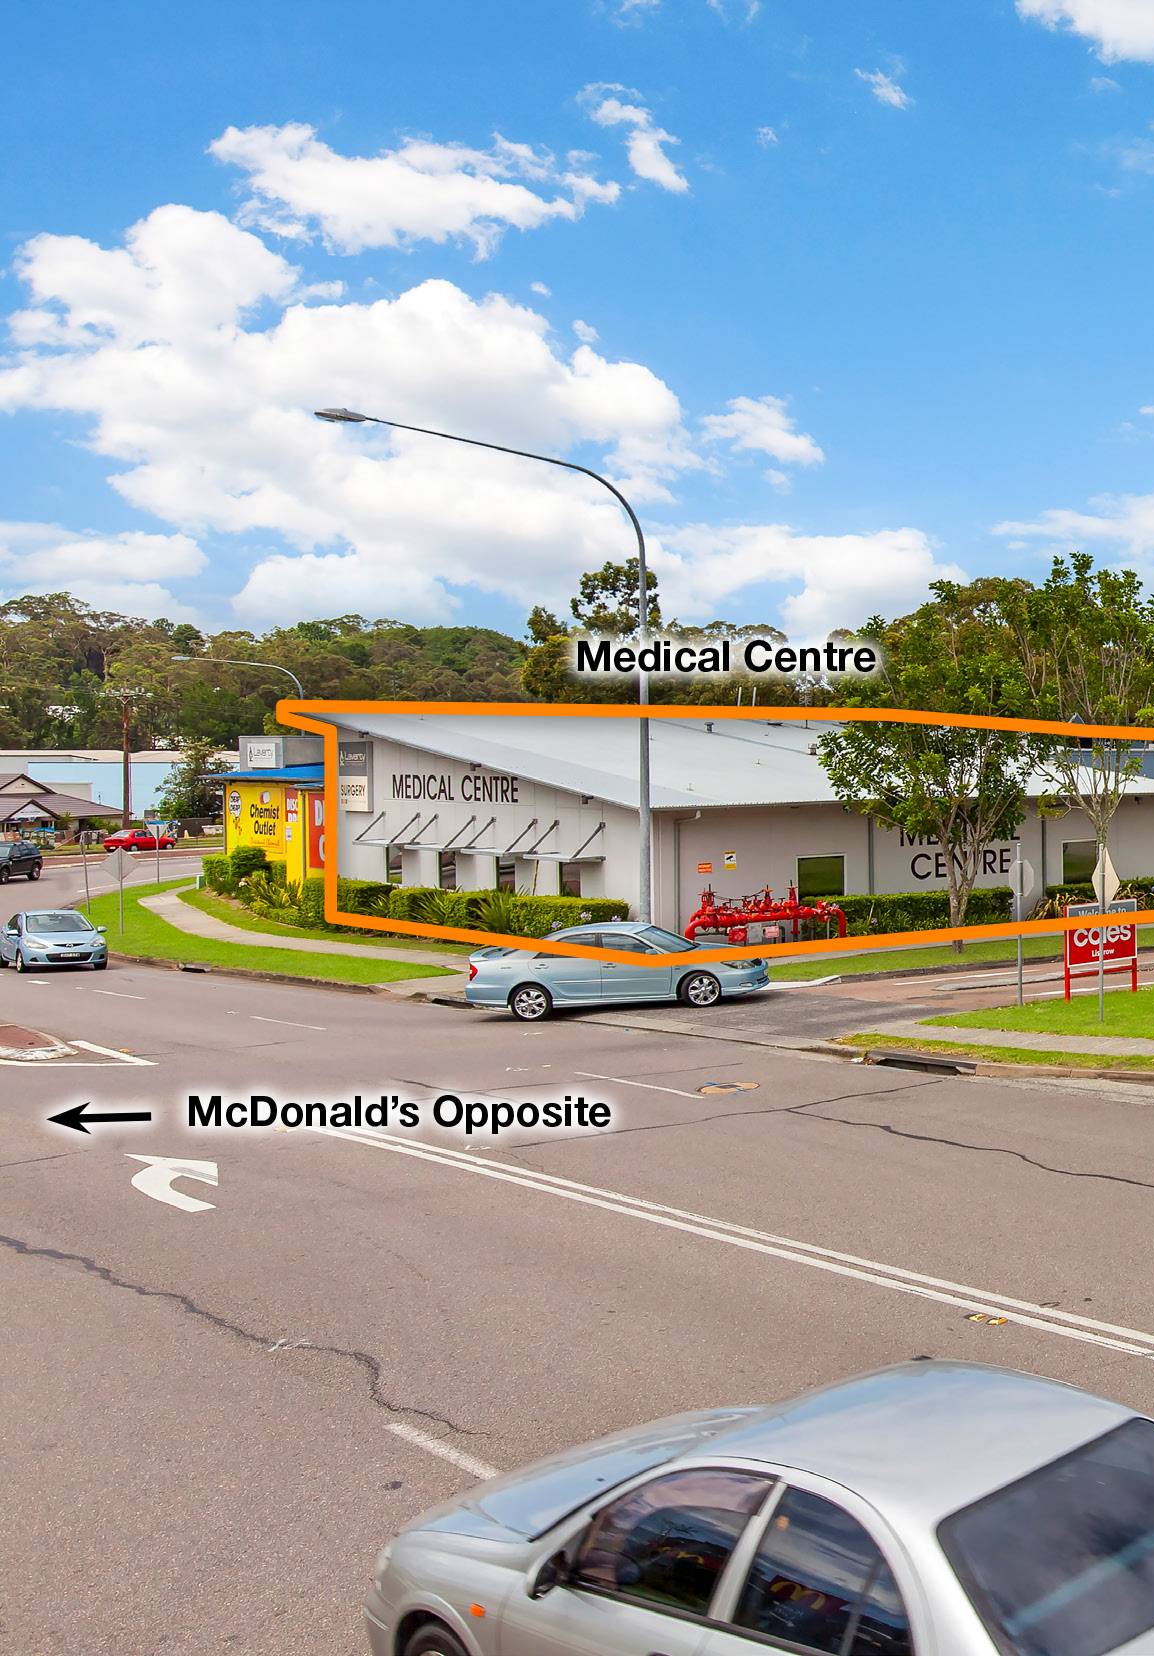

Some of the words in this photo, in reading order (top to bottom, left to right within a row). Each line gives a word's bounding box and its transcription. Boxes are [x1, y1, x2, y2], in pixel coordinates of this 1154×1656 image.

[341, 785, 365, 797] SURGERY
[392, 774, 455, 800] MEDICAL
[461, 774, 519, 803] CENTRE
[249, 803, 280, 820] Chemist
[253, 820, 276, 836] Outlet
[910, 848, 1012, 880] CENRE
[1073, 924, 1132, 948] coles
[1091, 949, 1115, 957] Lisrow
